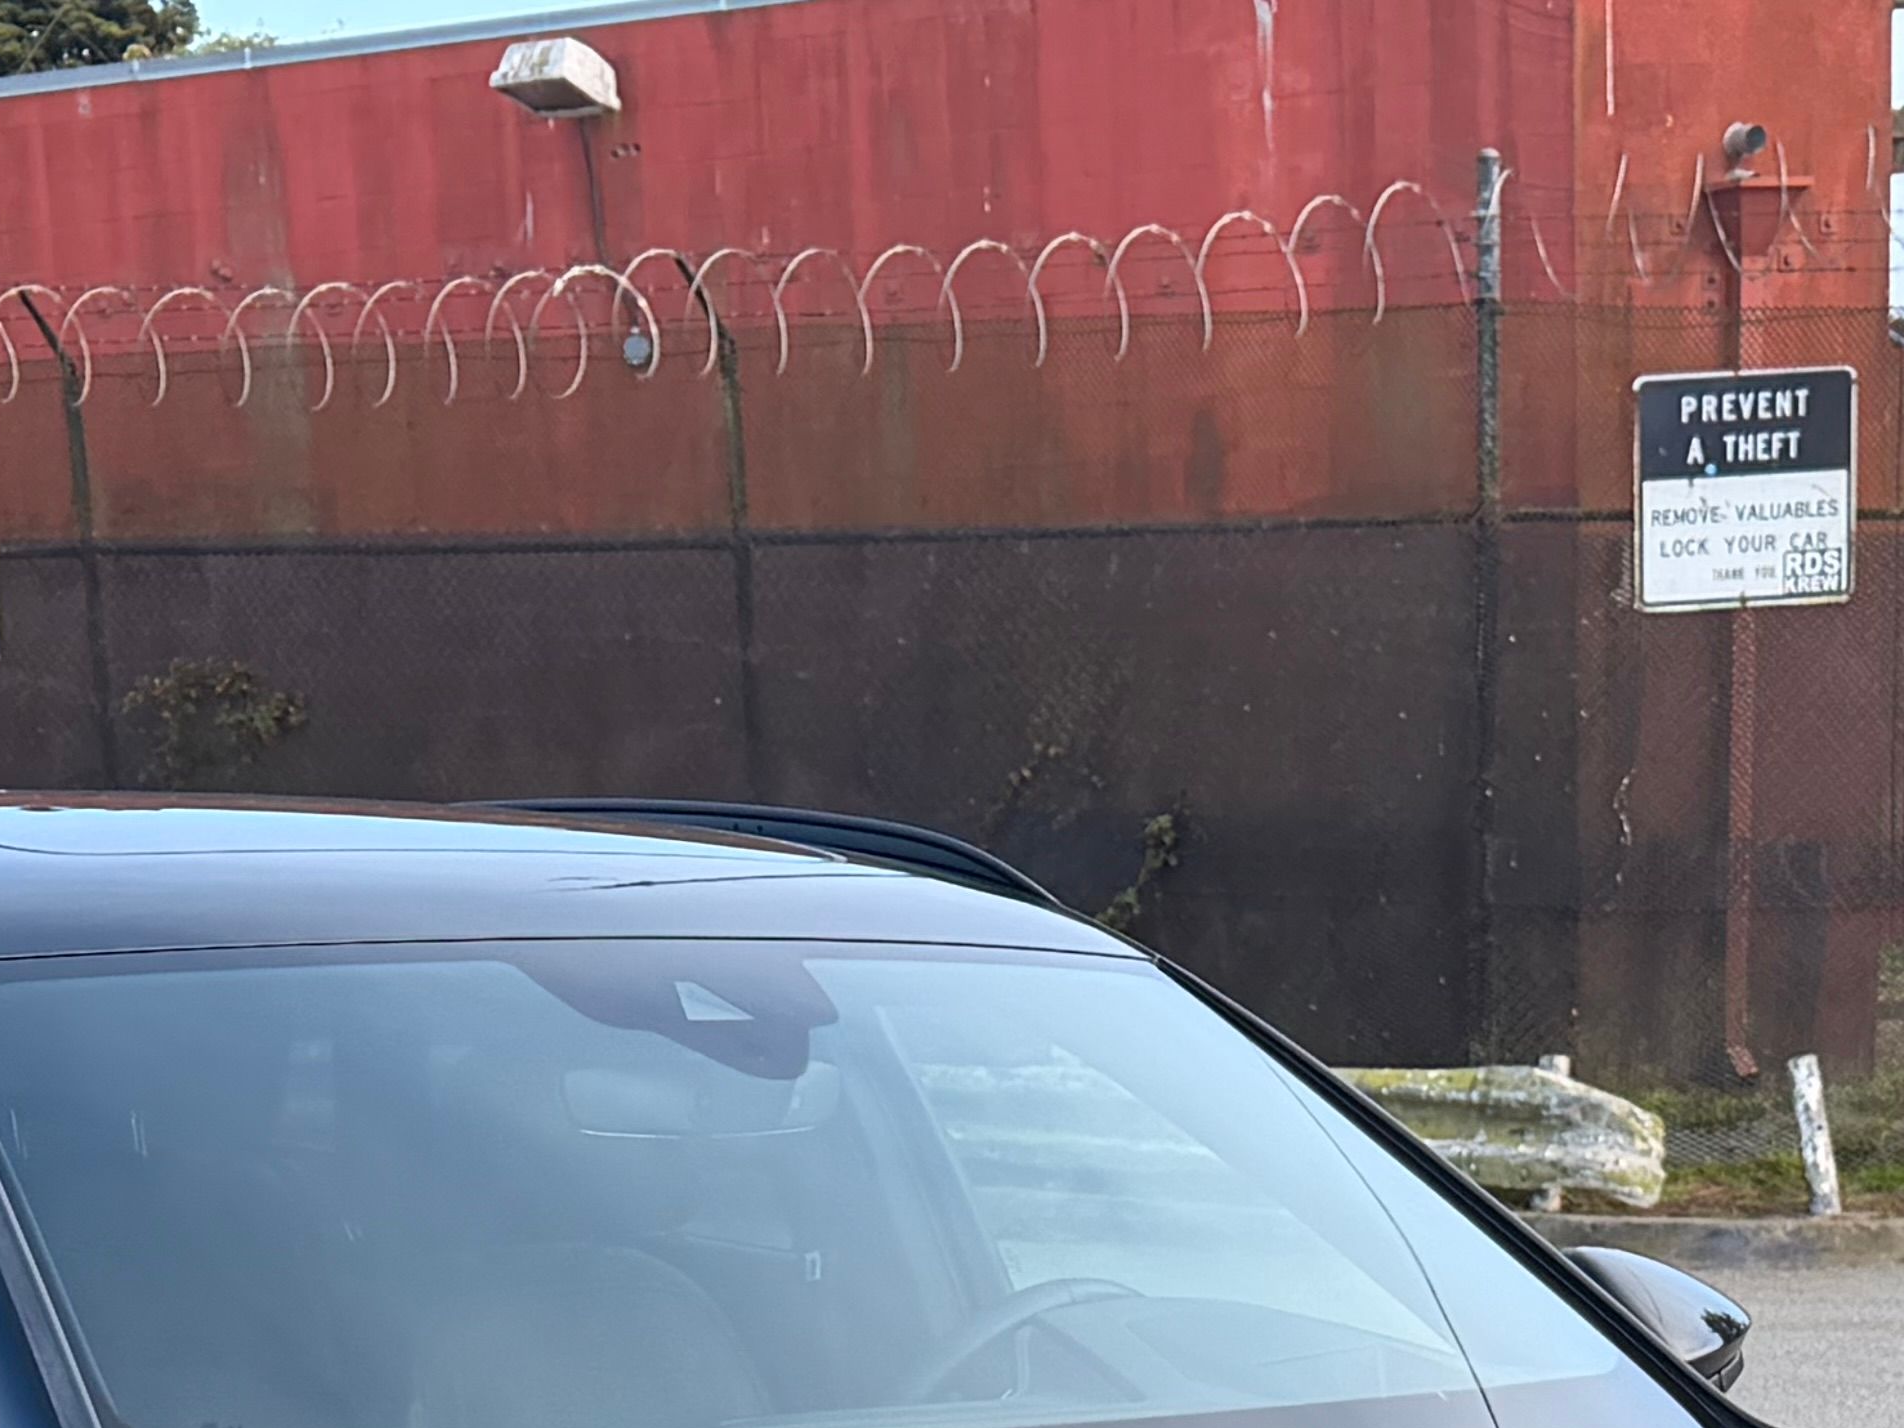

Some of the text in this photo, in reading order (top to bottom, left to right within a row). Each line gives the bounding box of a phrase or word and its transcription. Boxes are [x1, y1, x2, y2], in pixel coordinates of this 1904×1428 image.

[1681, 388, 1809, 424] PREVENT
[1686, 431, 1801, 465] A THEFT
[1651, 499, 1840, 528] REMOVE VALUABLES
[1659, 531, 1828, 558] LOCK YOUR CAR
[1786, 550, 1841, 577] RDS
[1784, 575, 1840, 593] KREW
